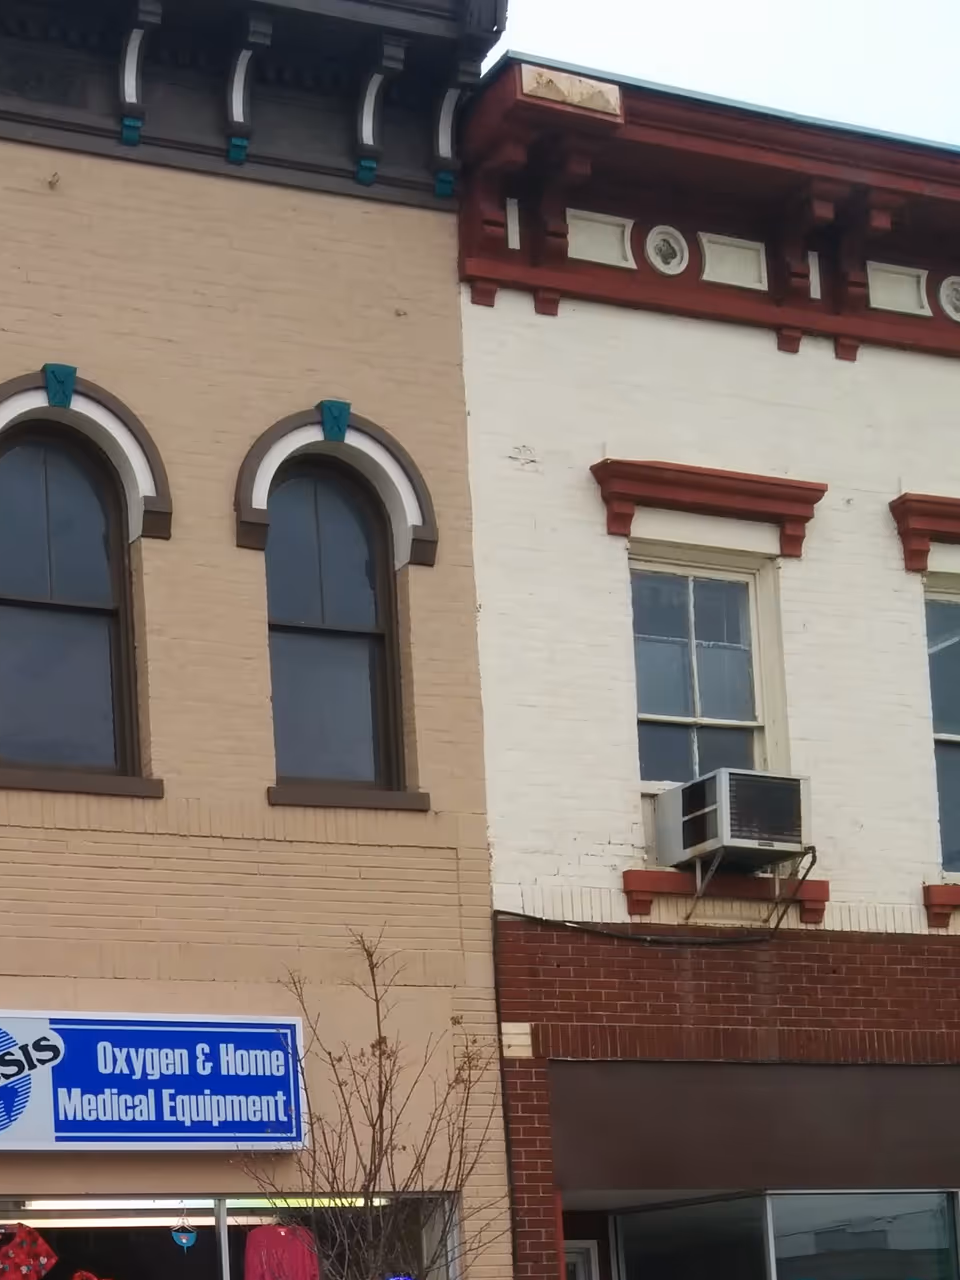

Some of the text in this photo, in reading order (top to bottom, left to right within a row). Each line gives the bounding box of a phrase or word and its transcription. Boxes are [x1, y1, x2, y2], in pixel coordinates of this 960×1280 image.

[97, 1041, 285, 1080] Oxygen & Home
[58, 1088, 288, 1126] Medical Equipment
